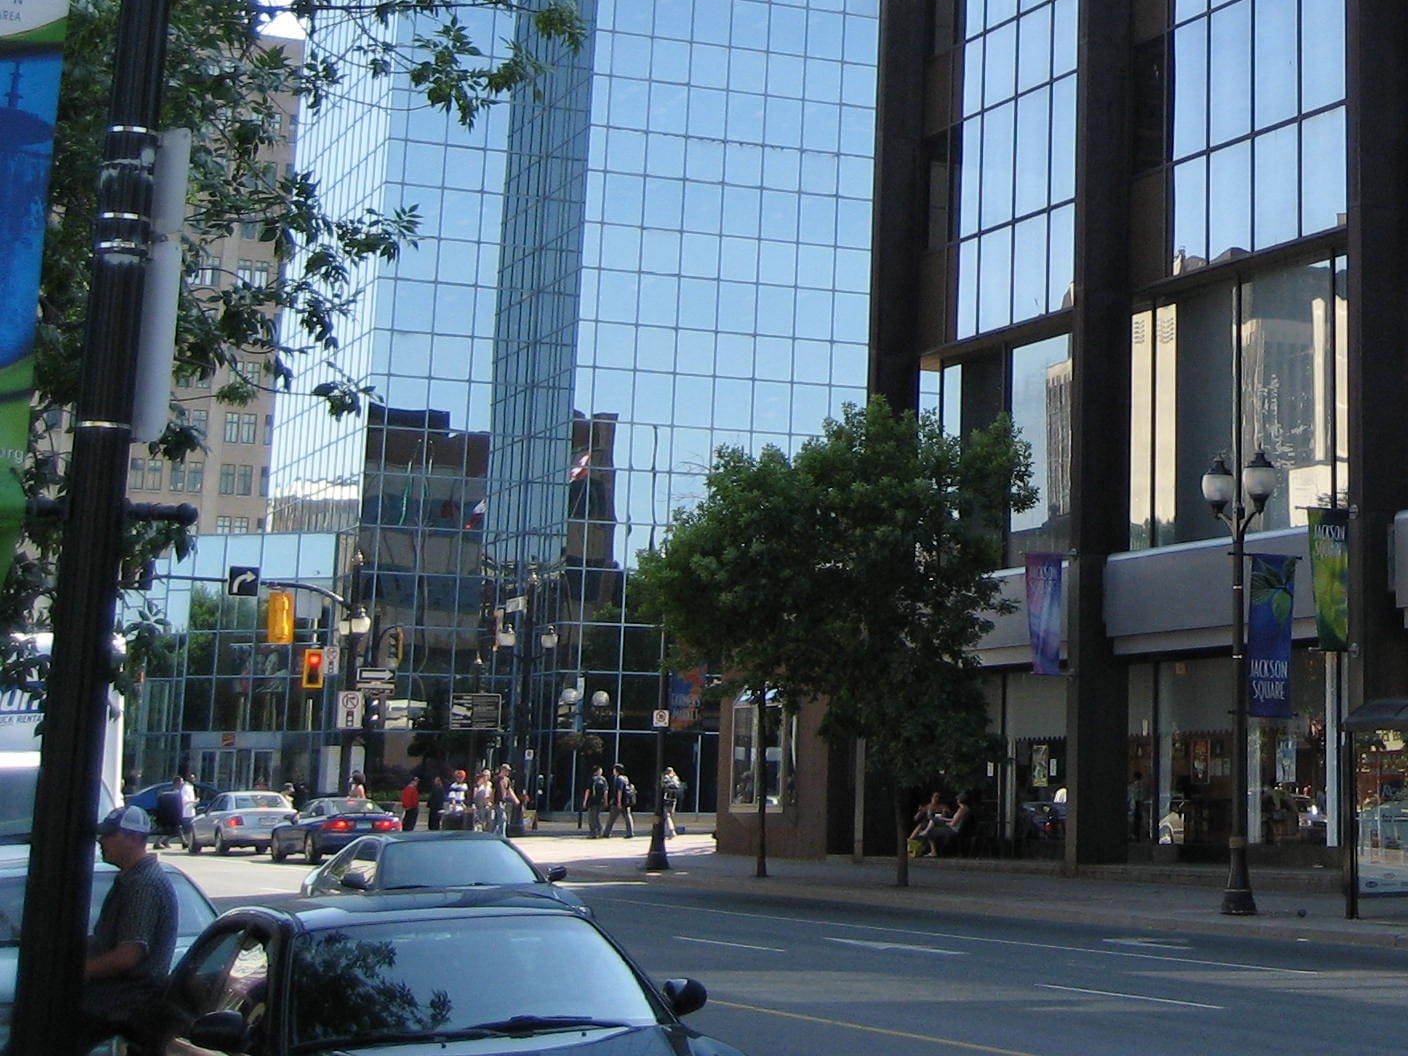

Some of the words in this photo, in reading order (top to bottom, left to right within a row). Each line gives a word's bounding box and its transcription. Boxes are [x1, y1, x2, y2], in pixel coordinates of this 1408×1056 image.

[0, 10, 21, 22] REA
[1250, 658, 1288, 679] JACKSON
[1252, 679, 1286, 703] SQUARE
